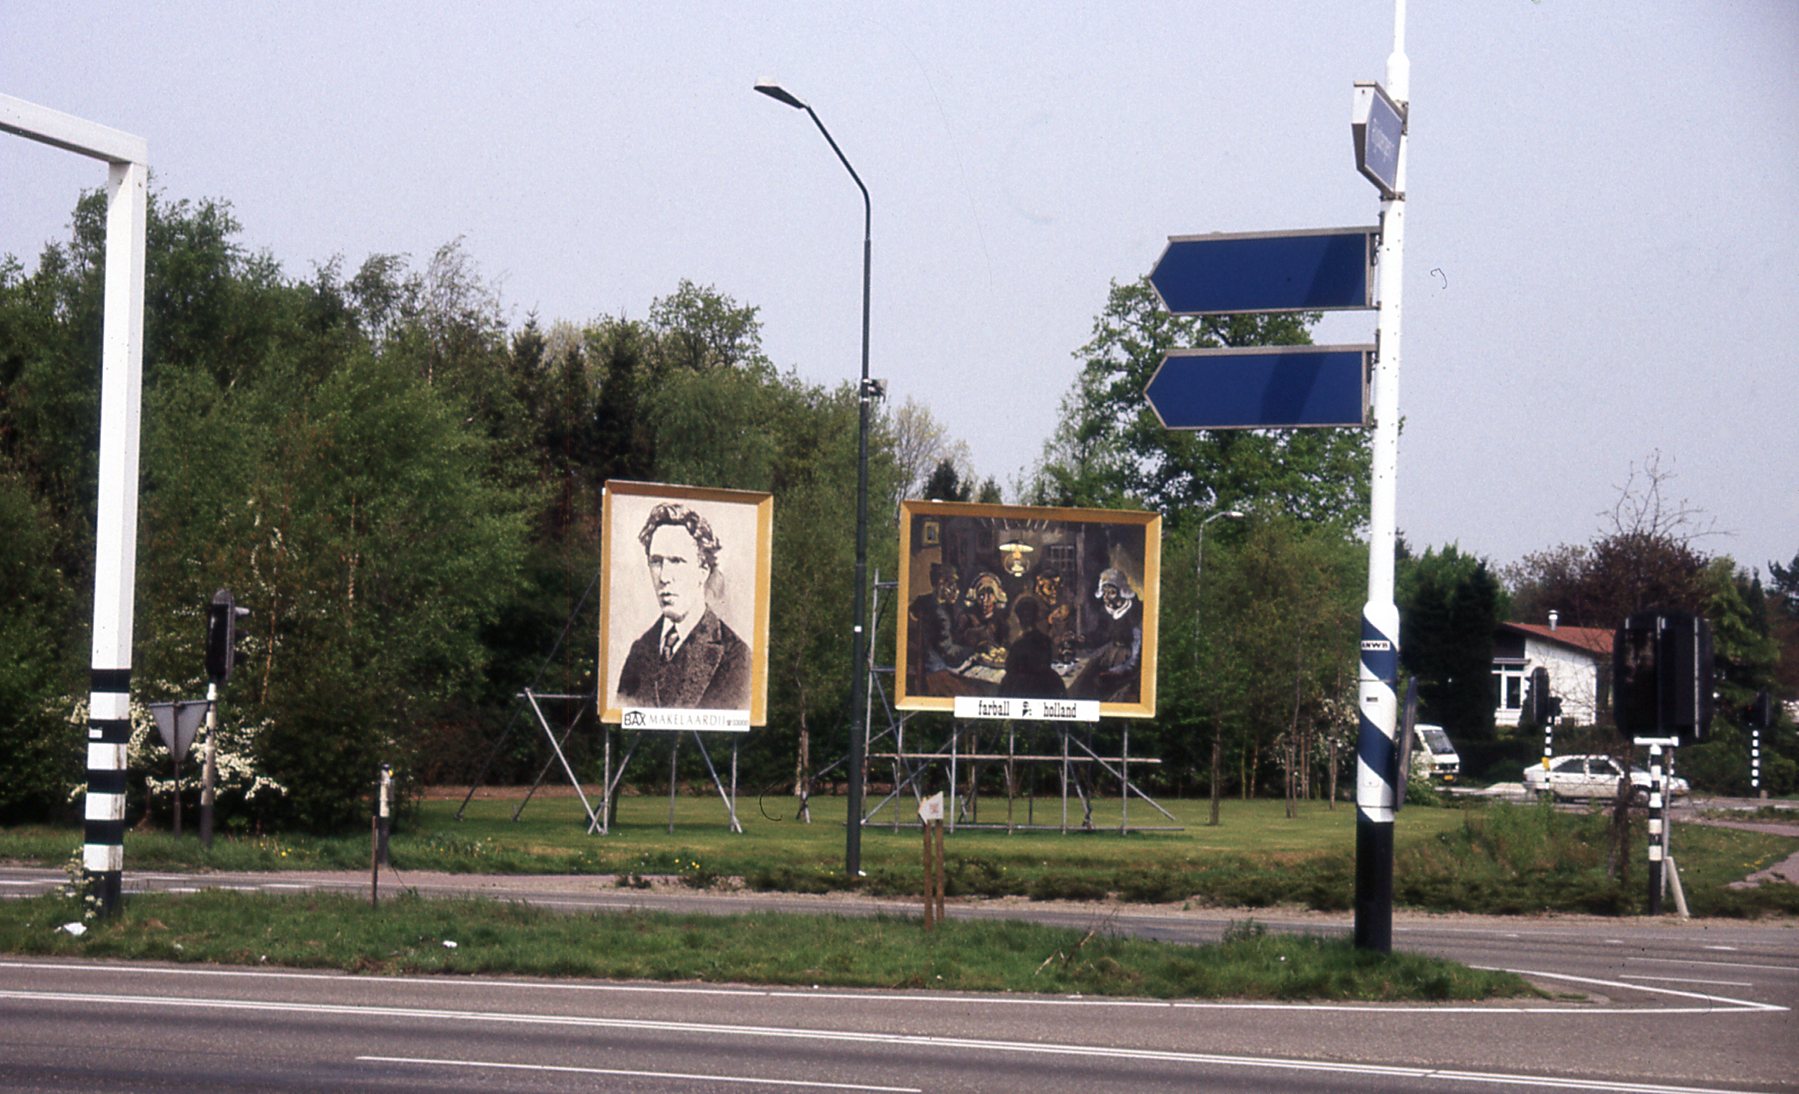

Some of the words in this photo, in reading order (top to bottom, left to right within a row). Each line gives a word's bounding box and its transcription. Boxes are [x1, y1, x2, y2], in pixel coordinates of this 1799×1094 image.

[978, 700, 1010, 716] farball
[1043, 702, 1077, 718] holland
[624, 711, 646, 726] BAX
